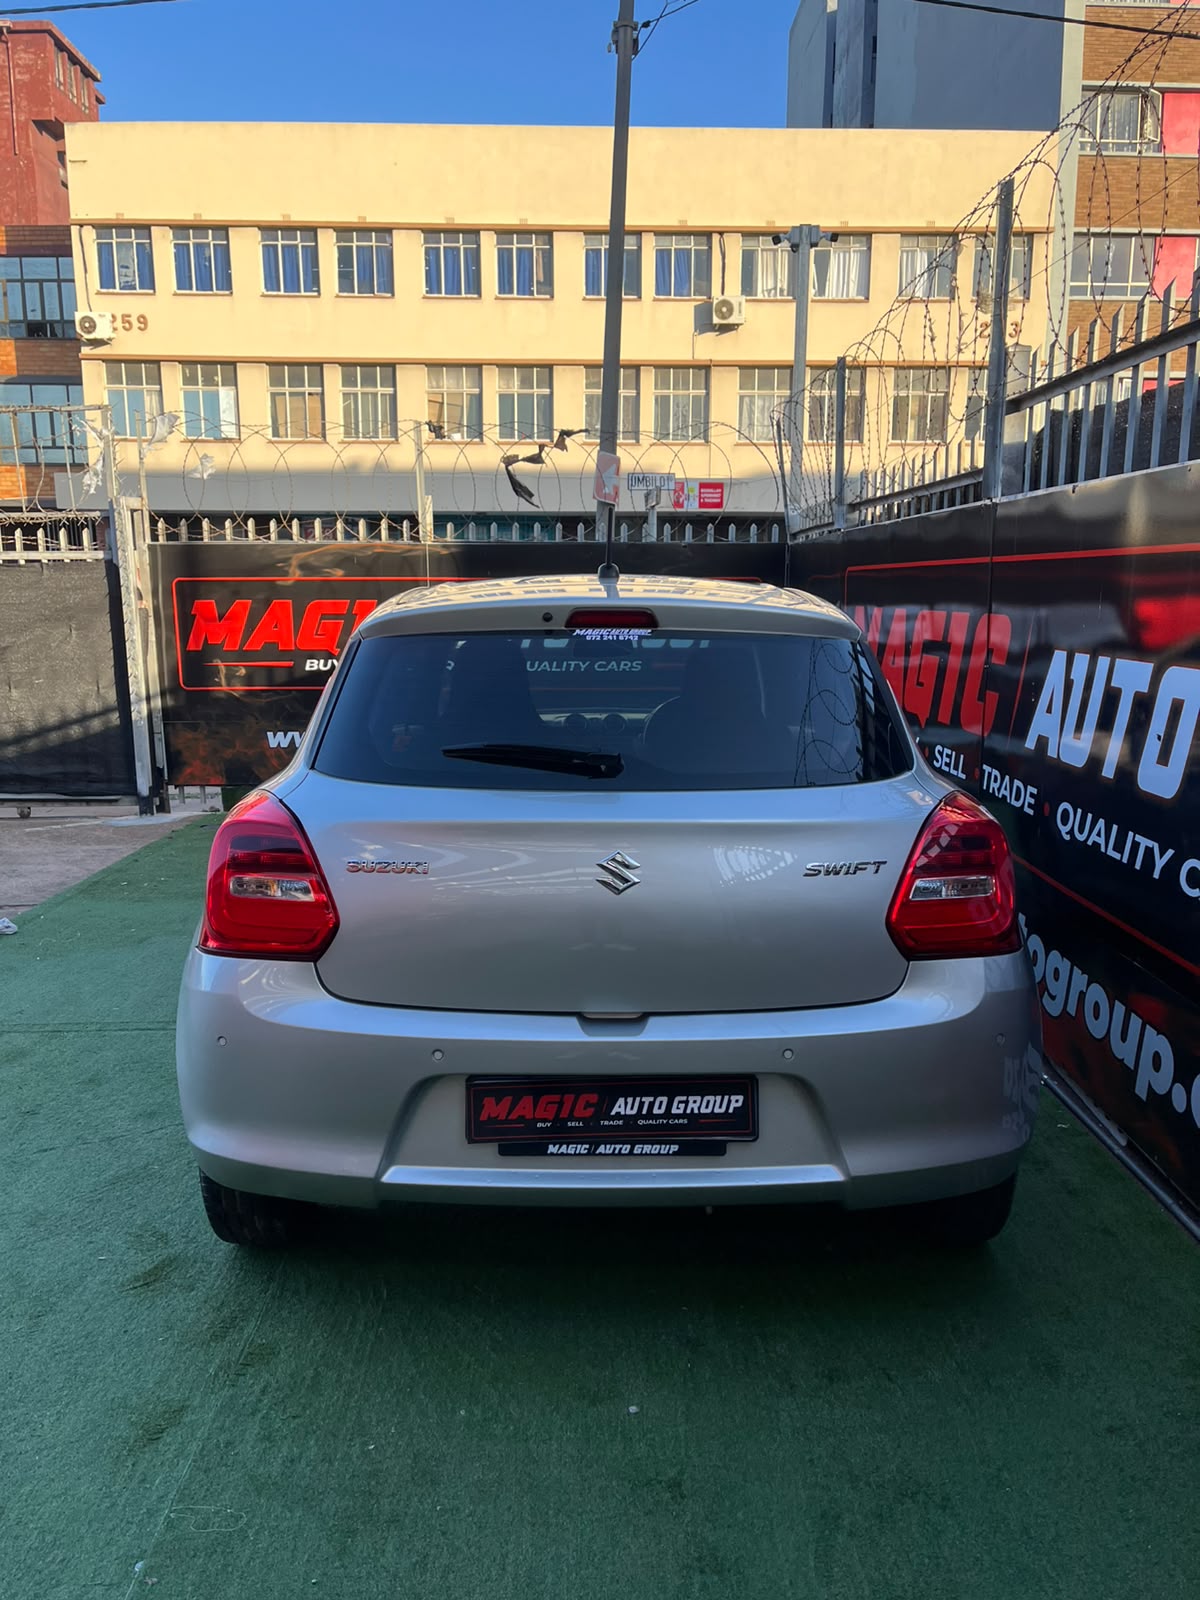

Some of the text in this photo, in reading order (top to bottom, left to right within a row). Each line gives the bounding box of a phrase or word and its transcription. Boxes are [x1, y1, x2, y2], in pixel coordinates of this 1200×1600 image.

[186, 599, 378, 656] MAGI
[525, 660, 643, 672] UALITY CARS
[1024, 649, 1200, 799] AUTO
[933, 744, 967, 780] SELL
[982, 764, 1038, 816] TRADE
[1056, 801, 1175, 881] QUALITY
[345, 860, 430, 875] SUZUKI
[802, 860, 888, 878] SWIFT
[479, 1093, 744, 1121] MAGIC AUTO GROUP
[546, 1144, 680, 1155] MAGIC AUTO GROUP
